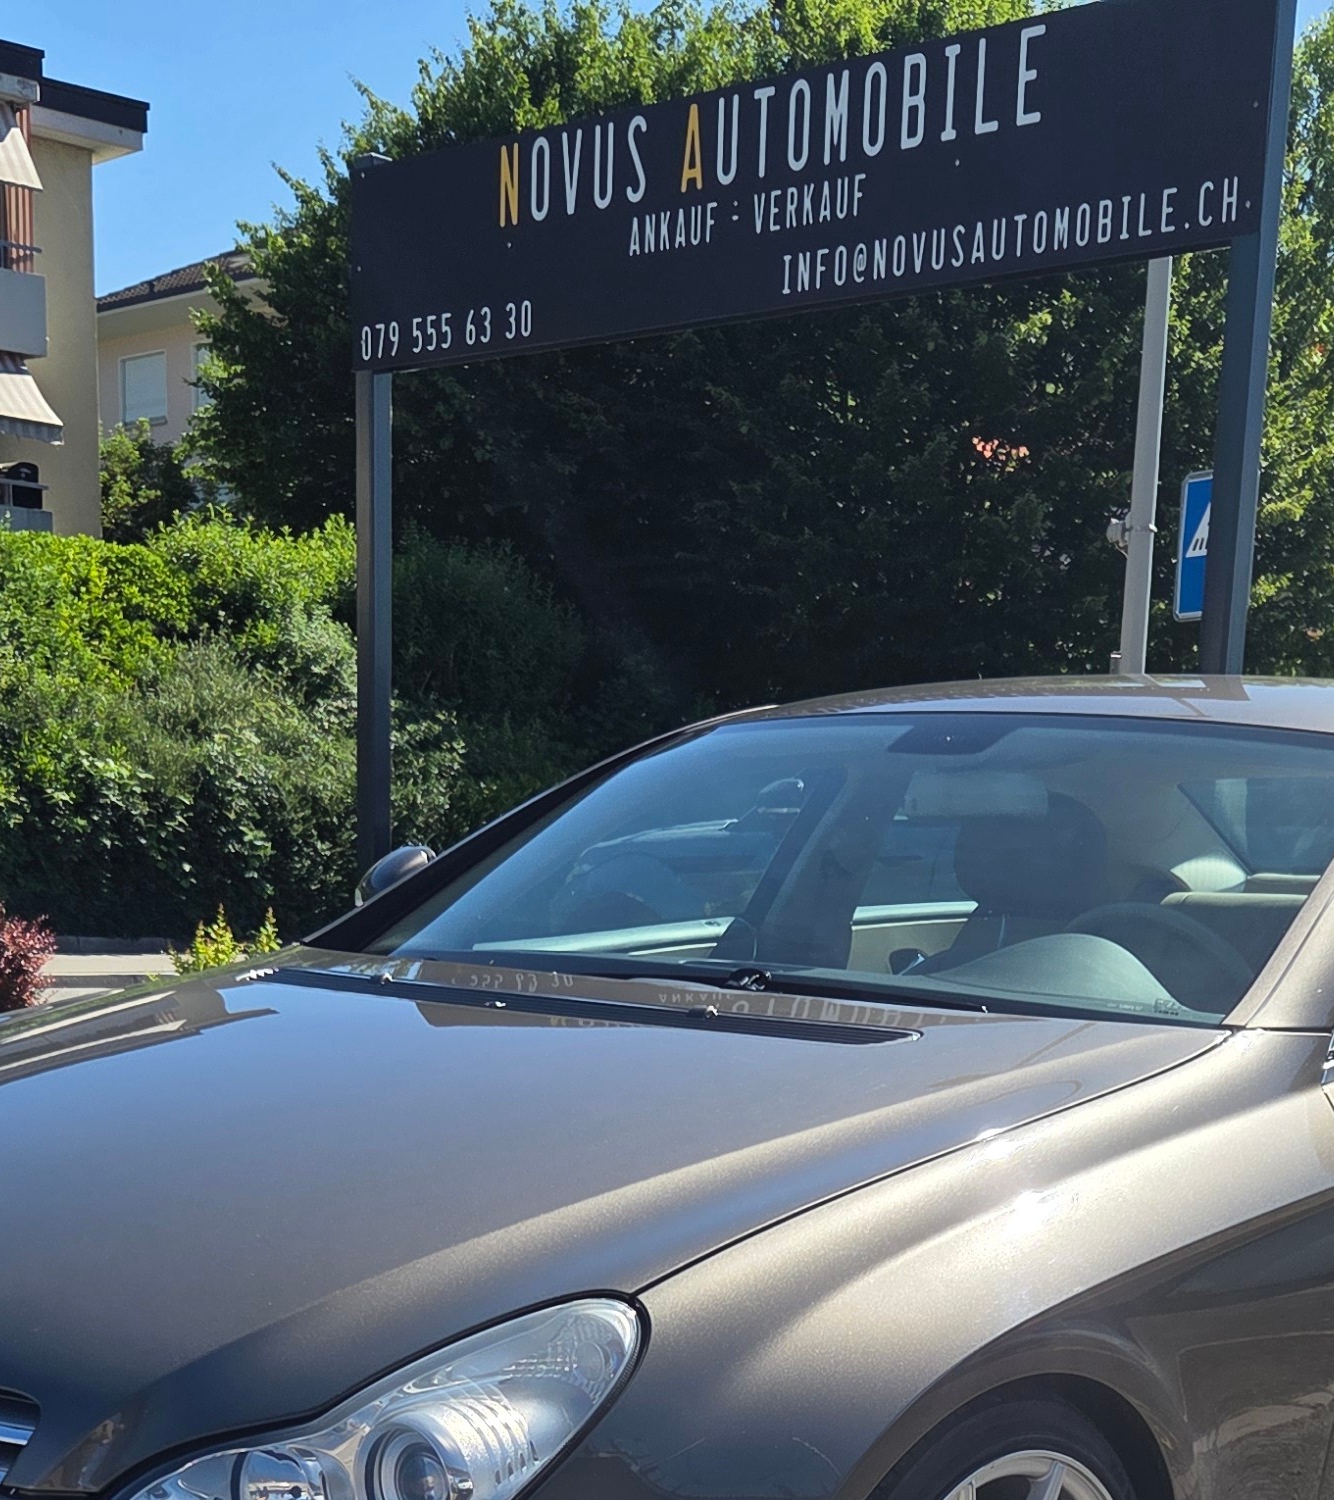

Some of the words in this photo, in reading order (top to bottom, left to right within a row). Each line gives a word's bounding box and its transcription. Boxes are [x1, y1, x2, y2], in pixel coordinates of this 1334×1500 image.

[498, 115, 648, 228] NOVUS
[680, 24, 1047, 193] AUTOMOBILE
[628, 201, 718, 257] ANKAUF
[753, 173, 866, 235] VERKAUF
[781, 176, 1240, 295] INFO@NOVUSAUTOMOBILE.CH
[361, 321, 399, 361] 079
[412, 312, 452, 353] 555
[465, 306, 492, 345] 63
[505, 300, 532, 338] 30
